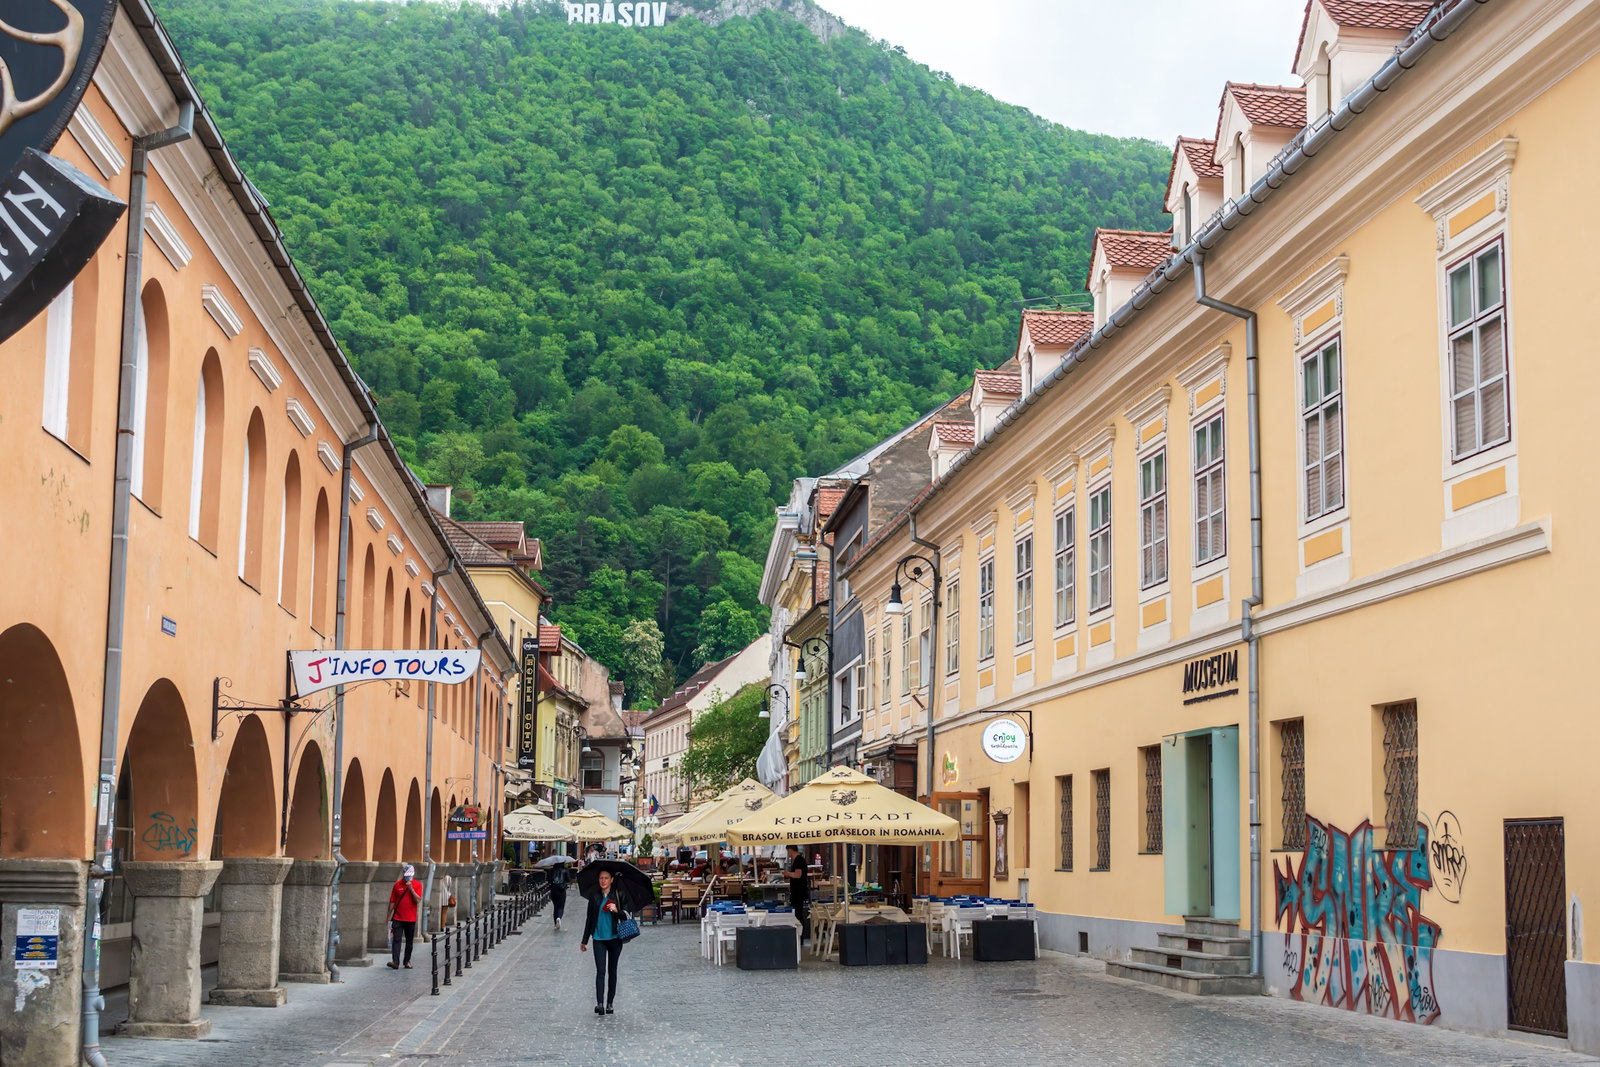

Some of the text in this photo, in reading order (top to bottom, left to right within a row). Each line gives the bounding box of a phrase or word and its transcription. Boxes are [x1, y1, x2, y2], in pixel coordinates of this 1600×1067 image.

[394, 656, 466, 676] TOURS
[1182, 650, 1239, 694] MUSEUM
[526, 658, 534, 702] HOTEL
[774, 812, 913, 826] KRONSTADT
[787, 830, 822, 840] REGELE
[824, 828, 876, 838] ORAȘELOR
[879, 826, 890, 837] ÎN
[893, 826, 945, 837] ROMÂNIA.
